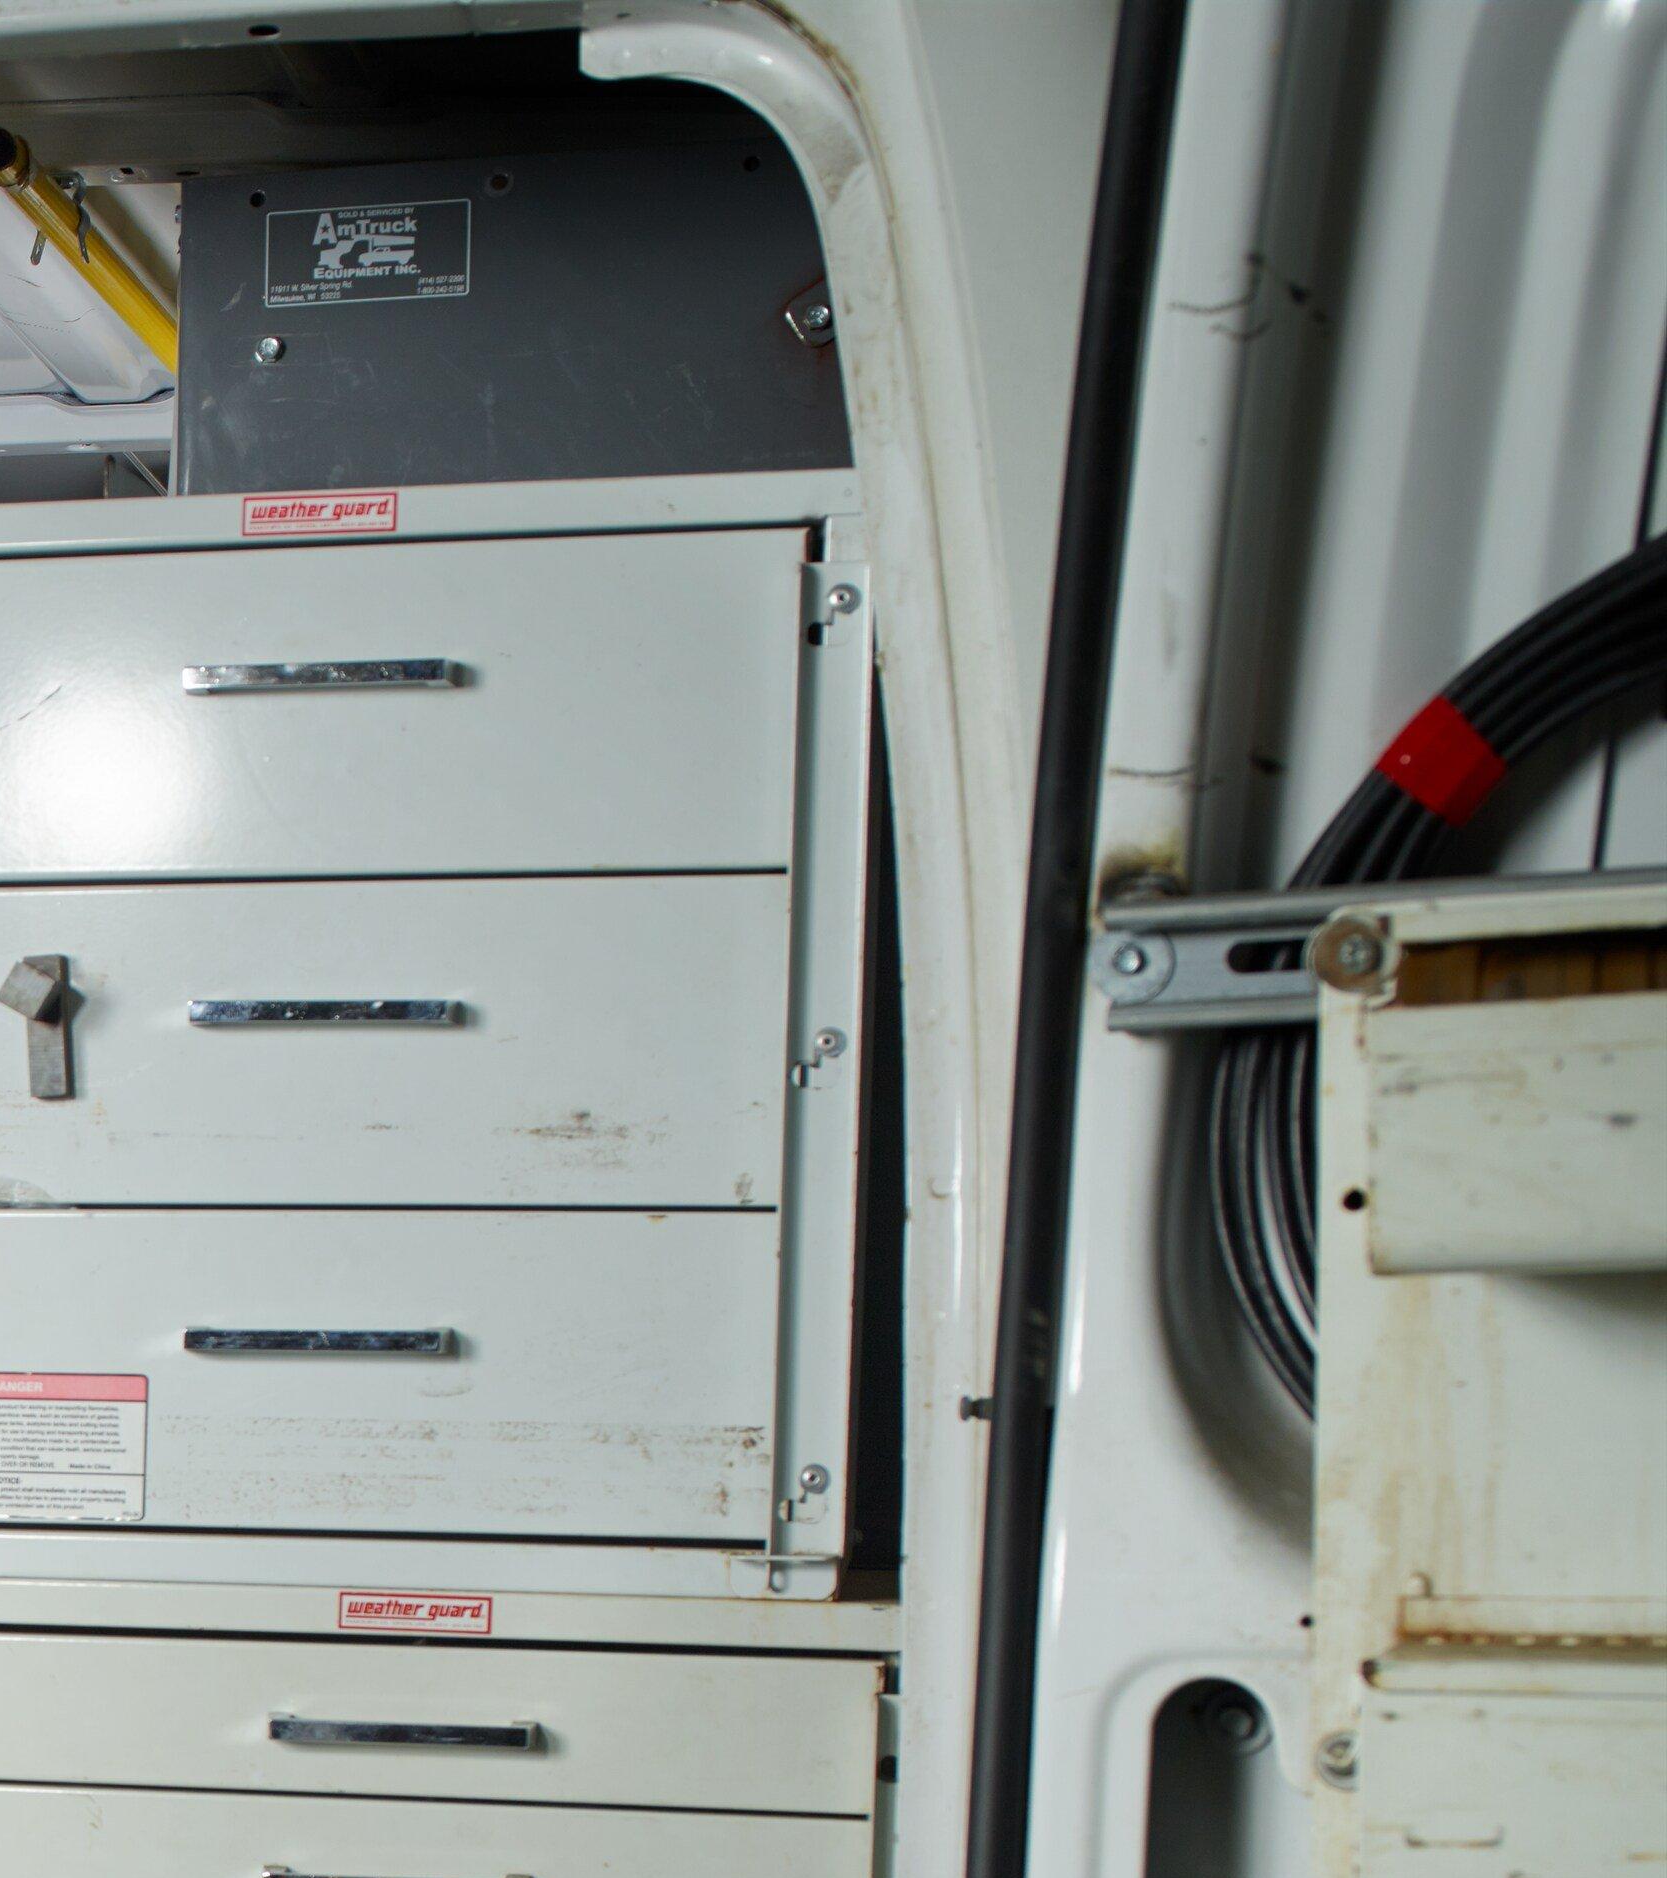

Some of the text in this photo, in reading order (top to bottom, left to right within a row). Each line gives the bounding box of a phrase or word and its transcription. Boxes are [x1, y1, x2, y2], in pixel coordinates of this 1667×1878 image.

[312, 212, 418, 246] AmTruck
[314, 264, 421, 280] EQUIPMENT INC.
[252, 499, 390, 521] weather guard
[347, 1600, 483, 1621] weather guard
